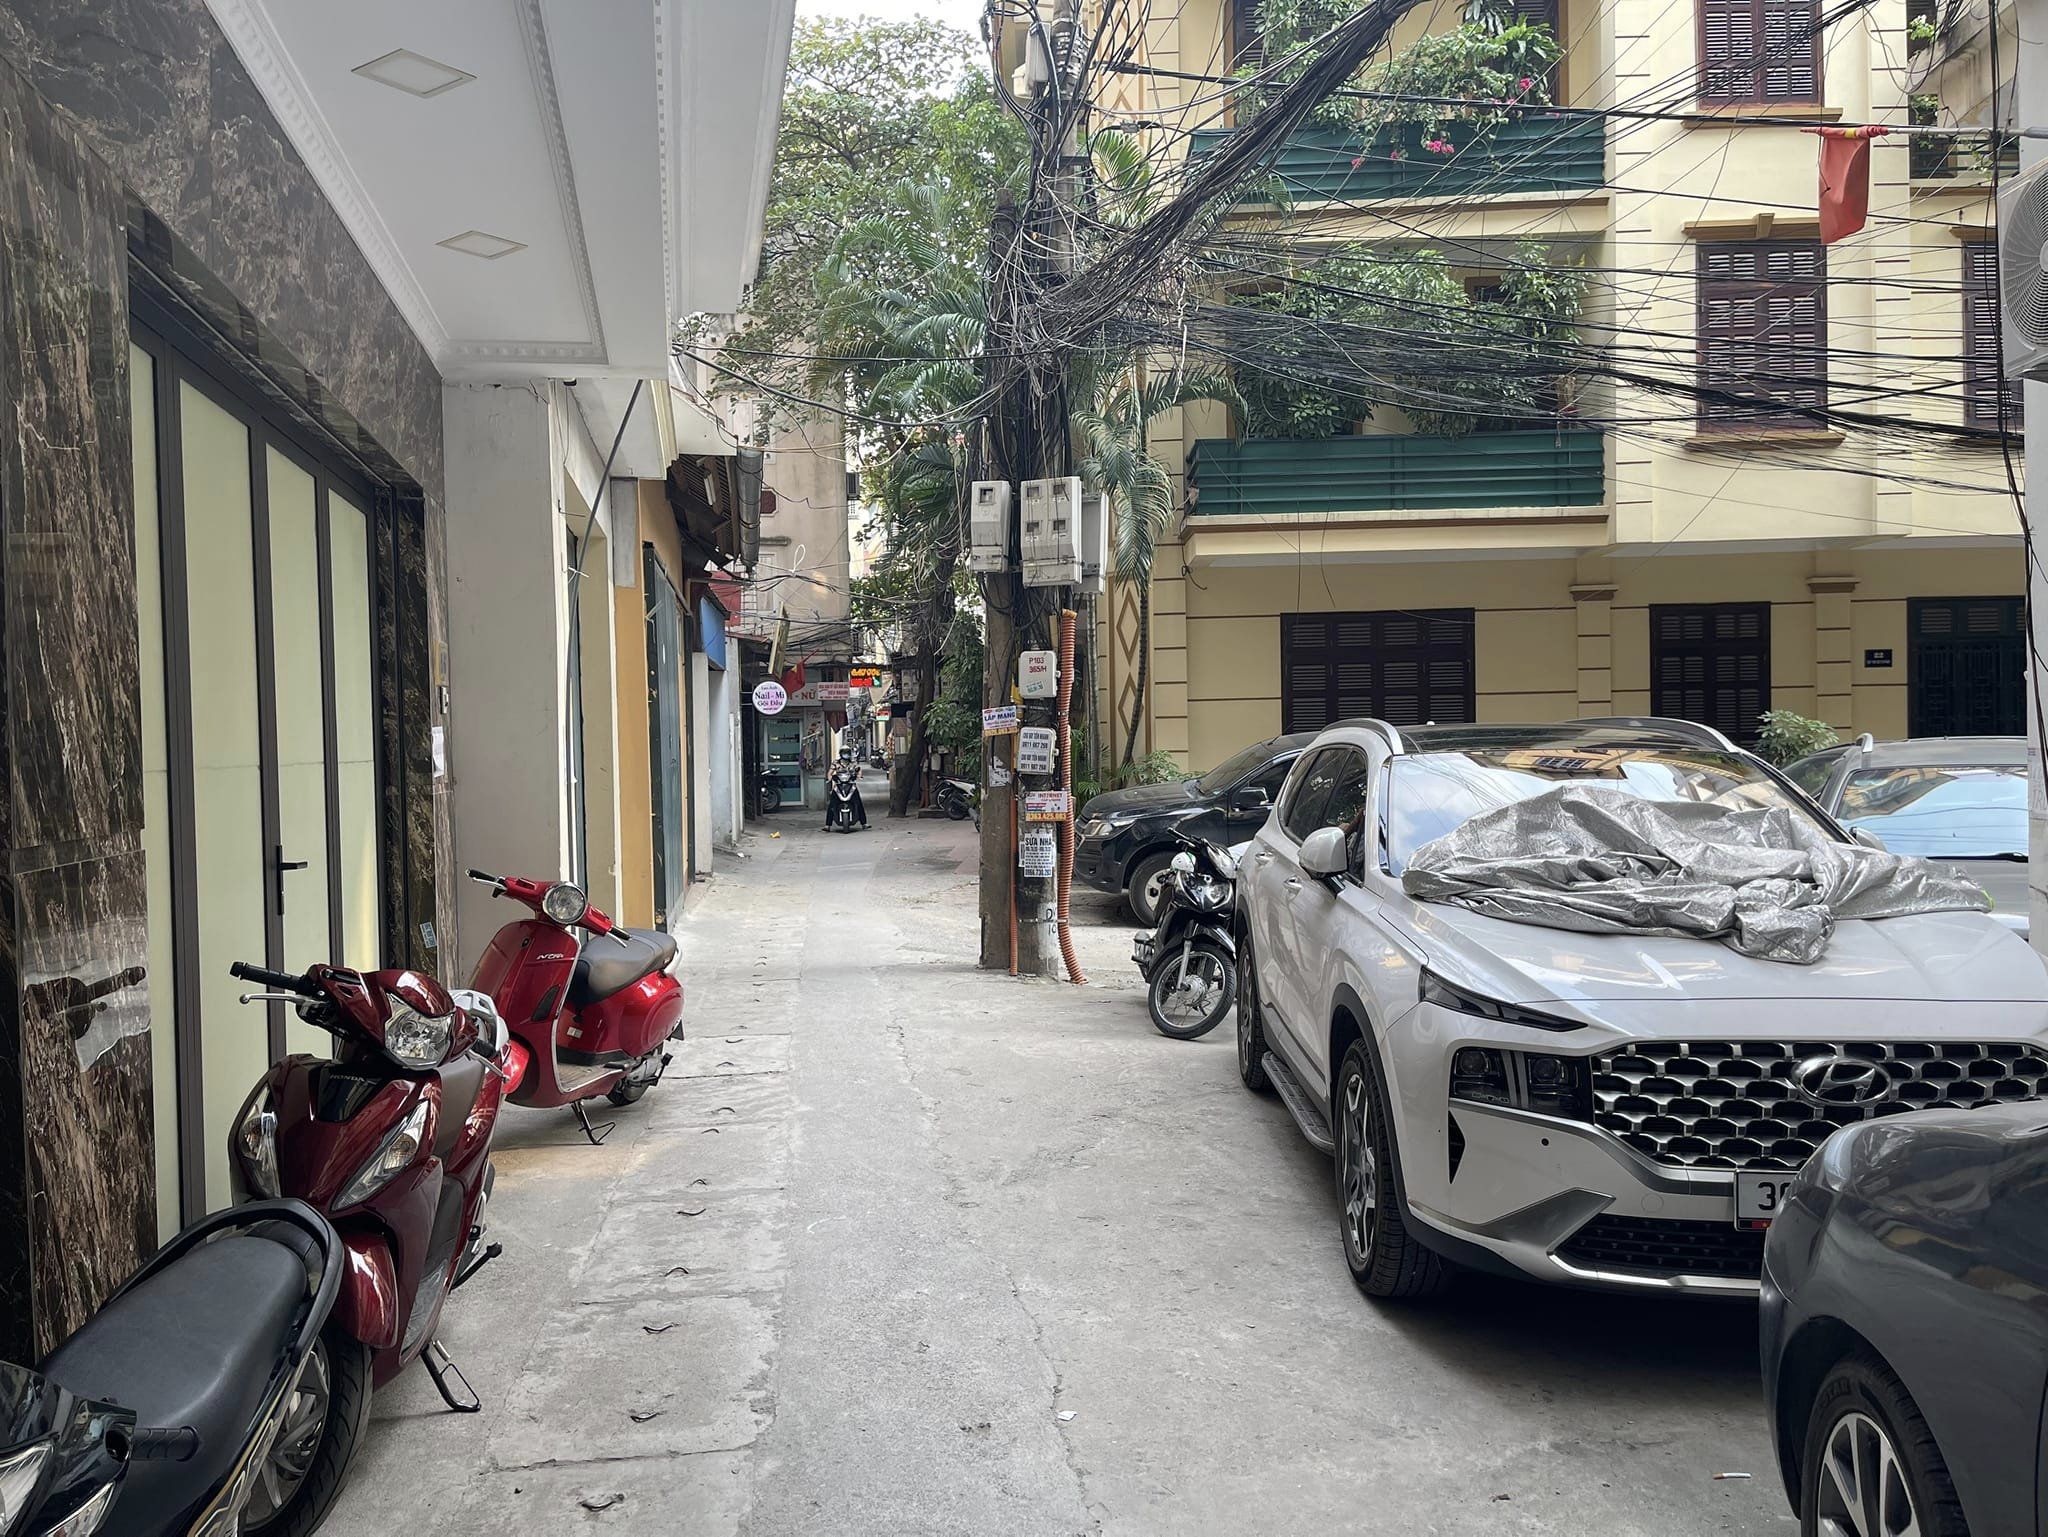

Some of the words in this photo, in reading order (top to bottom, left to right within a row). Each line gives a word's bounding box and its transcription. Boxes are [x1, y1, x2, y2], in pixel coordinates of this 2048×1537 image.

[755, 691, 770, 700] Nail
[1025, 834, 1038, 846] SỬA
[329, 1074, 365, 1082] HONDA
